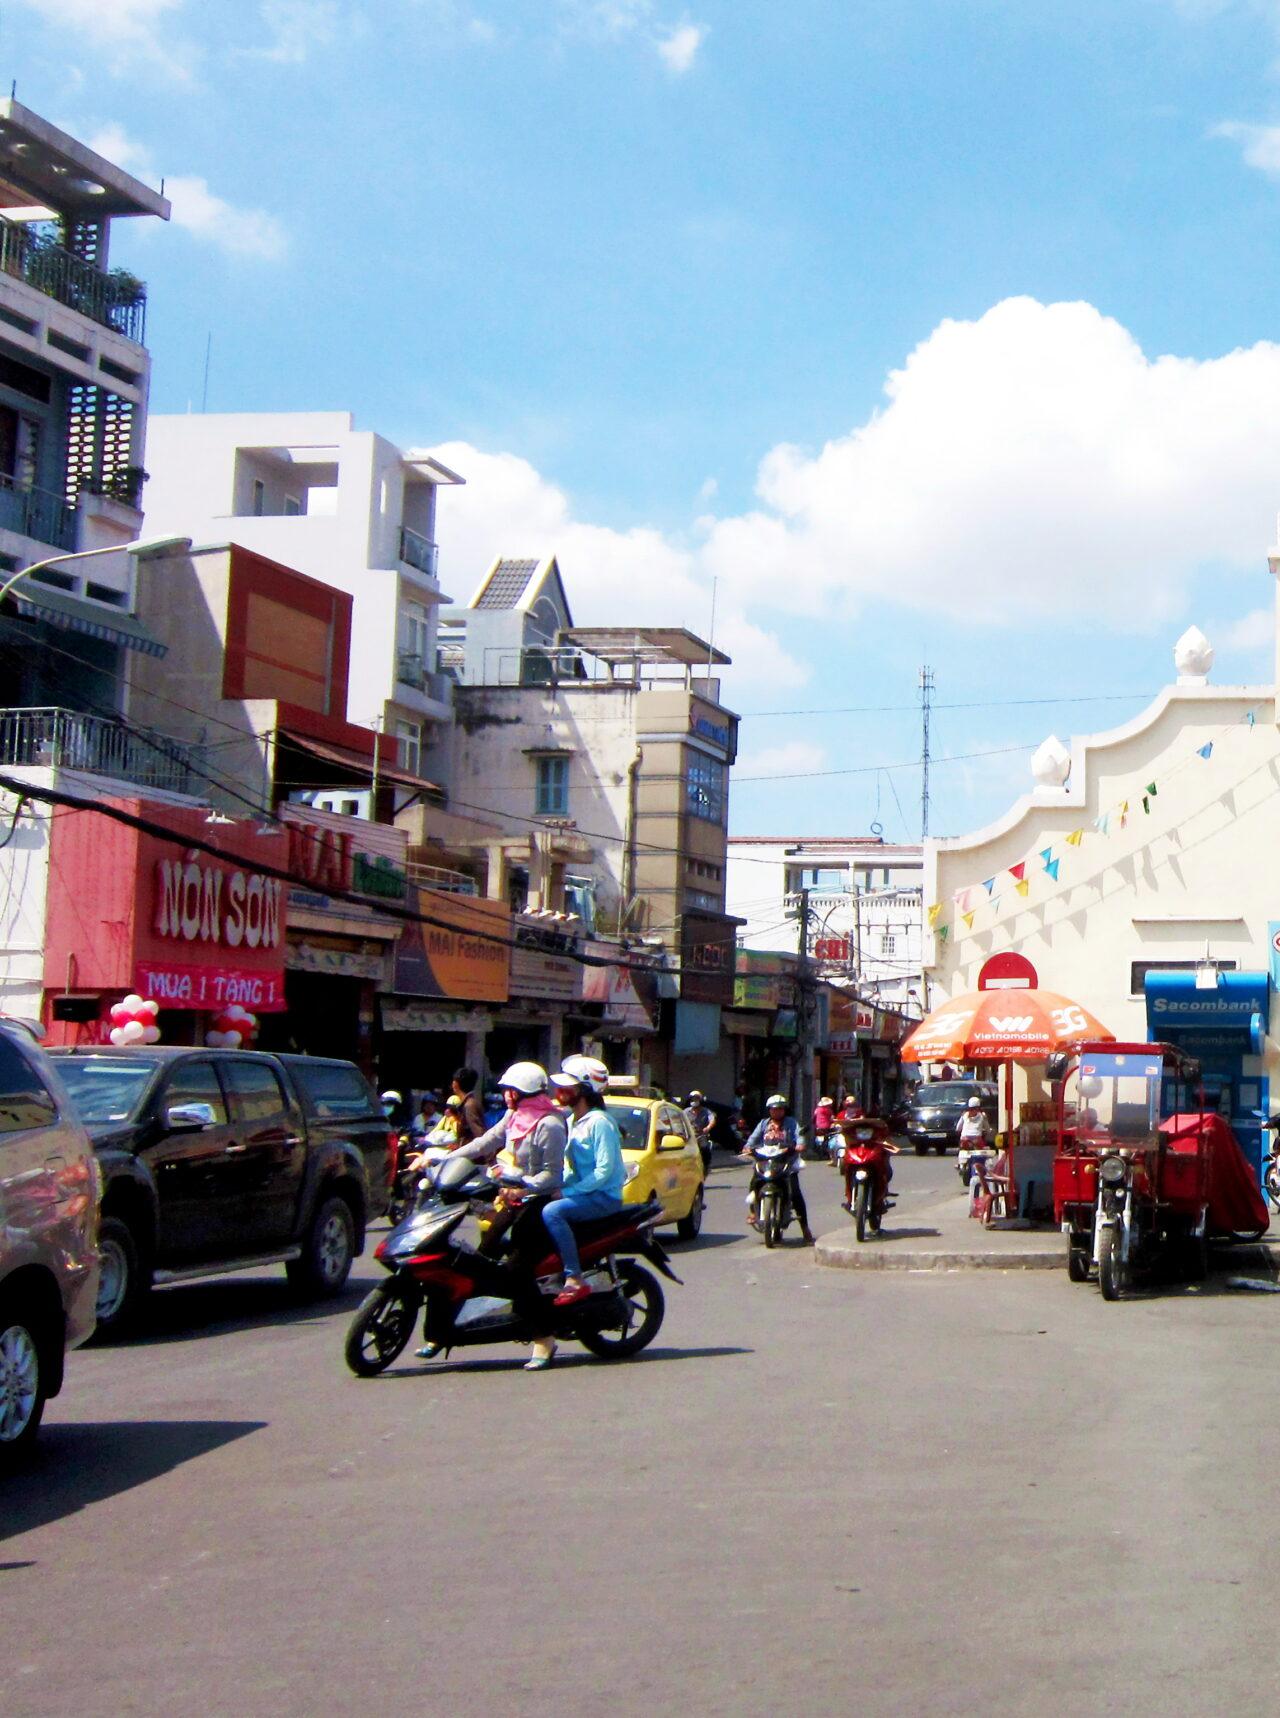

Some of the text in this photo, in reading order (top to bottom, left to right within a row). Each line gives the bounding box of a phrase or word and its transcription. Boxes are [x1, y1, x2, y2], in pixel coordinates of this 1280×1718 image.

[159, 848, 224, 943] NÓN
[226, 871, 282, 948] SƠN
[146, 971, 193, 999] MUA
[1152, 998, 1261, 1013] Sacombank
[1050, 1006, 1088, 1036] 3G
[974, 1032, 1050, 1041] Vietnamobile
